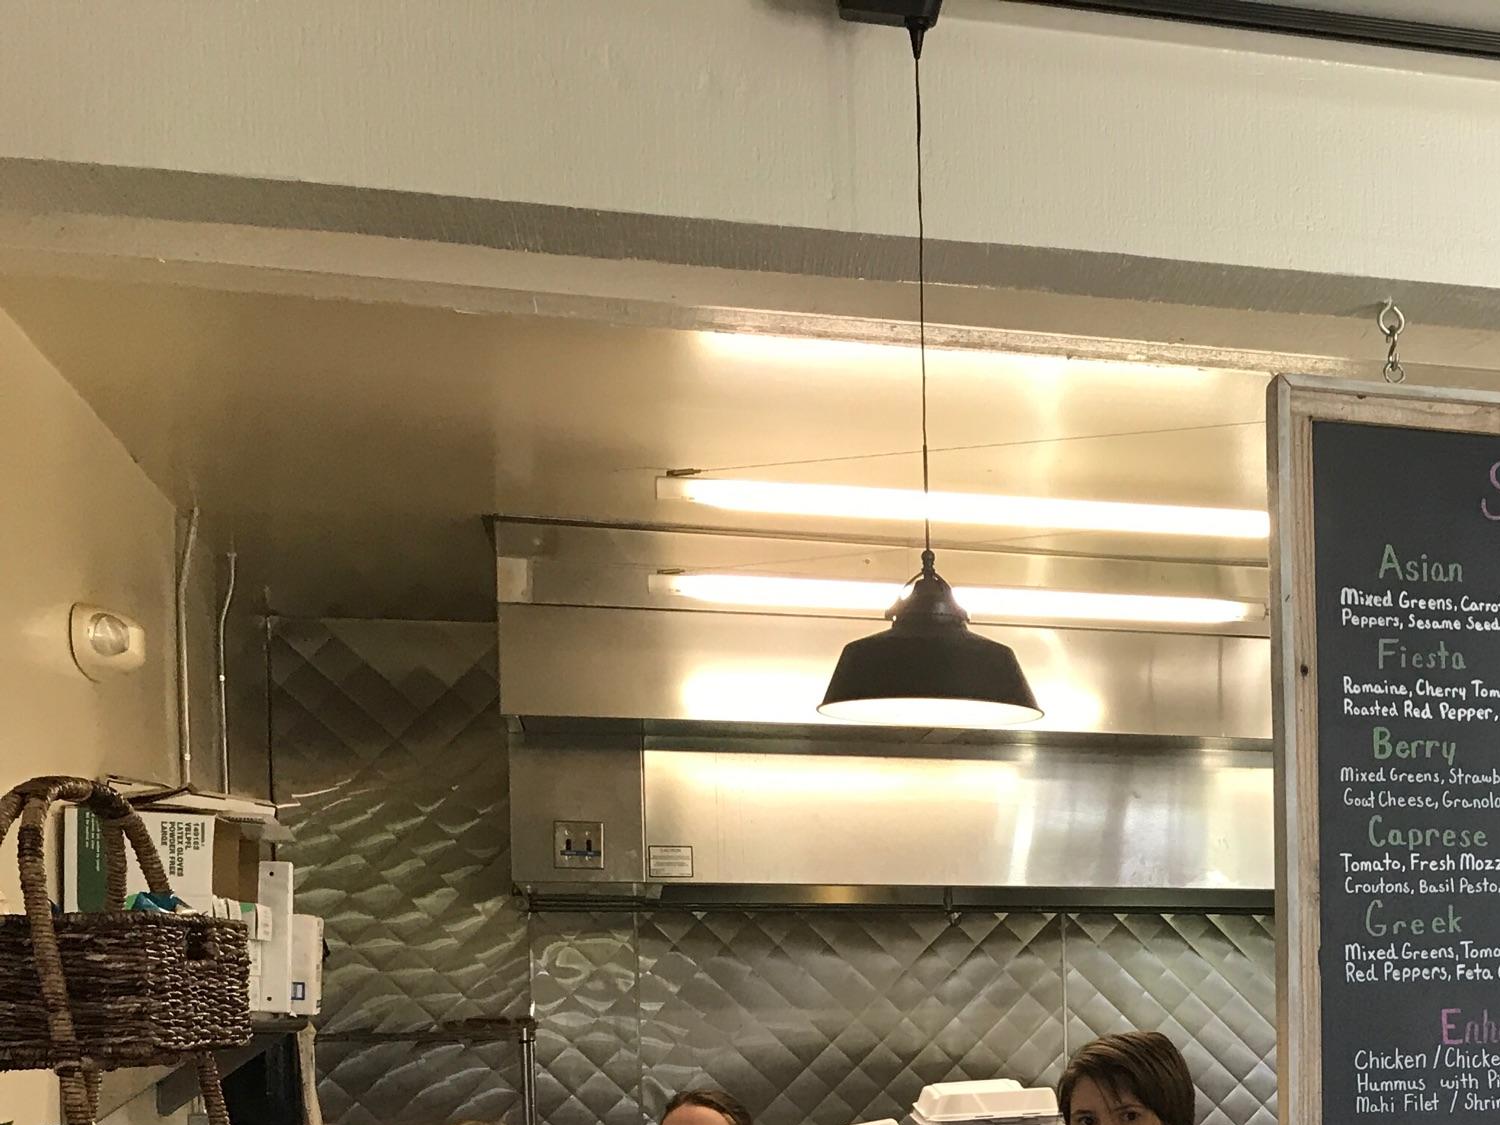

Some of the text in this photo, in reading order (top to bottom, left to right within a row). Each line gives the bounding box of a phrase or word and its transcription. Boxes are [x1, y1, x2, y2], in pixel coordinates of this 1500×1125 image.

[1378, 543, 1464, 583] Asian
[1342, 608, 1404, 631] Peppers,
[1408, 613, 1463, 631] Sesame
[1377, 638, 1466, 671] Fiesta
[1343, 676, 1413, 698] Romaine,
[1416, 679, 1468, 701] Cherry
[1372, 726, 1457, 765] Berry
[1368, 814, 1488, 850] Caprese
[1340, 852, 1407, 874] Tomato,
[1409, 852, 1457, 872] Fresh
[1345, 878, 1416, 895] Croutons,
[1419, 878, 1457, 895] Basil
[1365, 899, 1463, 938] Greek
[1346, 963, 1379, 982] Red
[1383, 963, 1453, 982] Peppers,
[1456, 962, 1493, 981] Feta
[1357, 1073, 1426, 1092] Hummus
[1440, 1072, 1479, 1091] with
